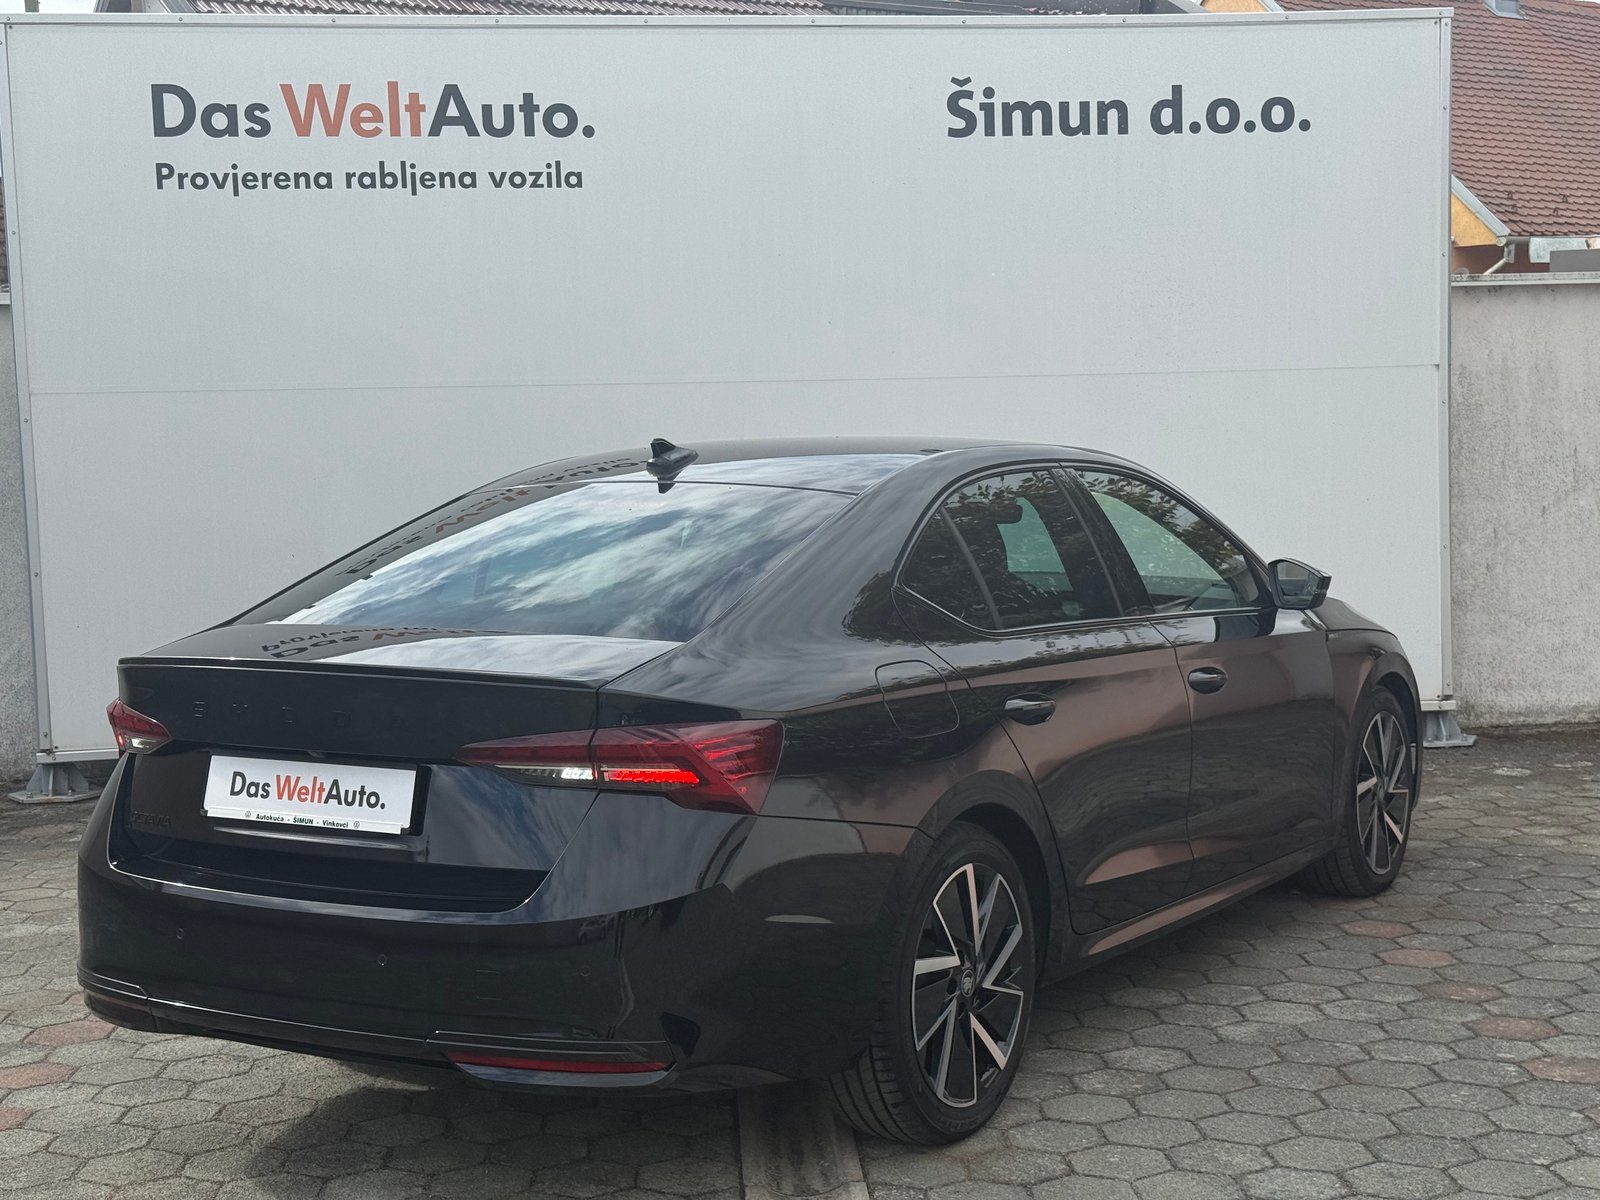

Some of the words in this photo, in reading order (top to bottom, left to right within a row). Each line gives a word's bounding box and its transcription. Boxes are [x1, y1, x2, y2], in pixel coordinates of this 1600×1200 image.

[151, 83, 271, 138] Das
[280, 81, 595, 138] WeltAuto.
[947, 77, 1128, 138] Šimun
[1150, 85, 1312, 135] d.o.o.
[156, 163, 332, 197] Provjerena
[345, 160, 477, 197] rabljena
[488, 160, 583, 189] vozila
[230, 771, 271, 800] Das
[276, 774, 386, 810] WeltAuto.
[293, 815, 314, 825] ŠIMUN
[322, 819, 349, 829] Vinkovci
